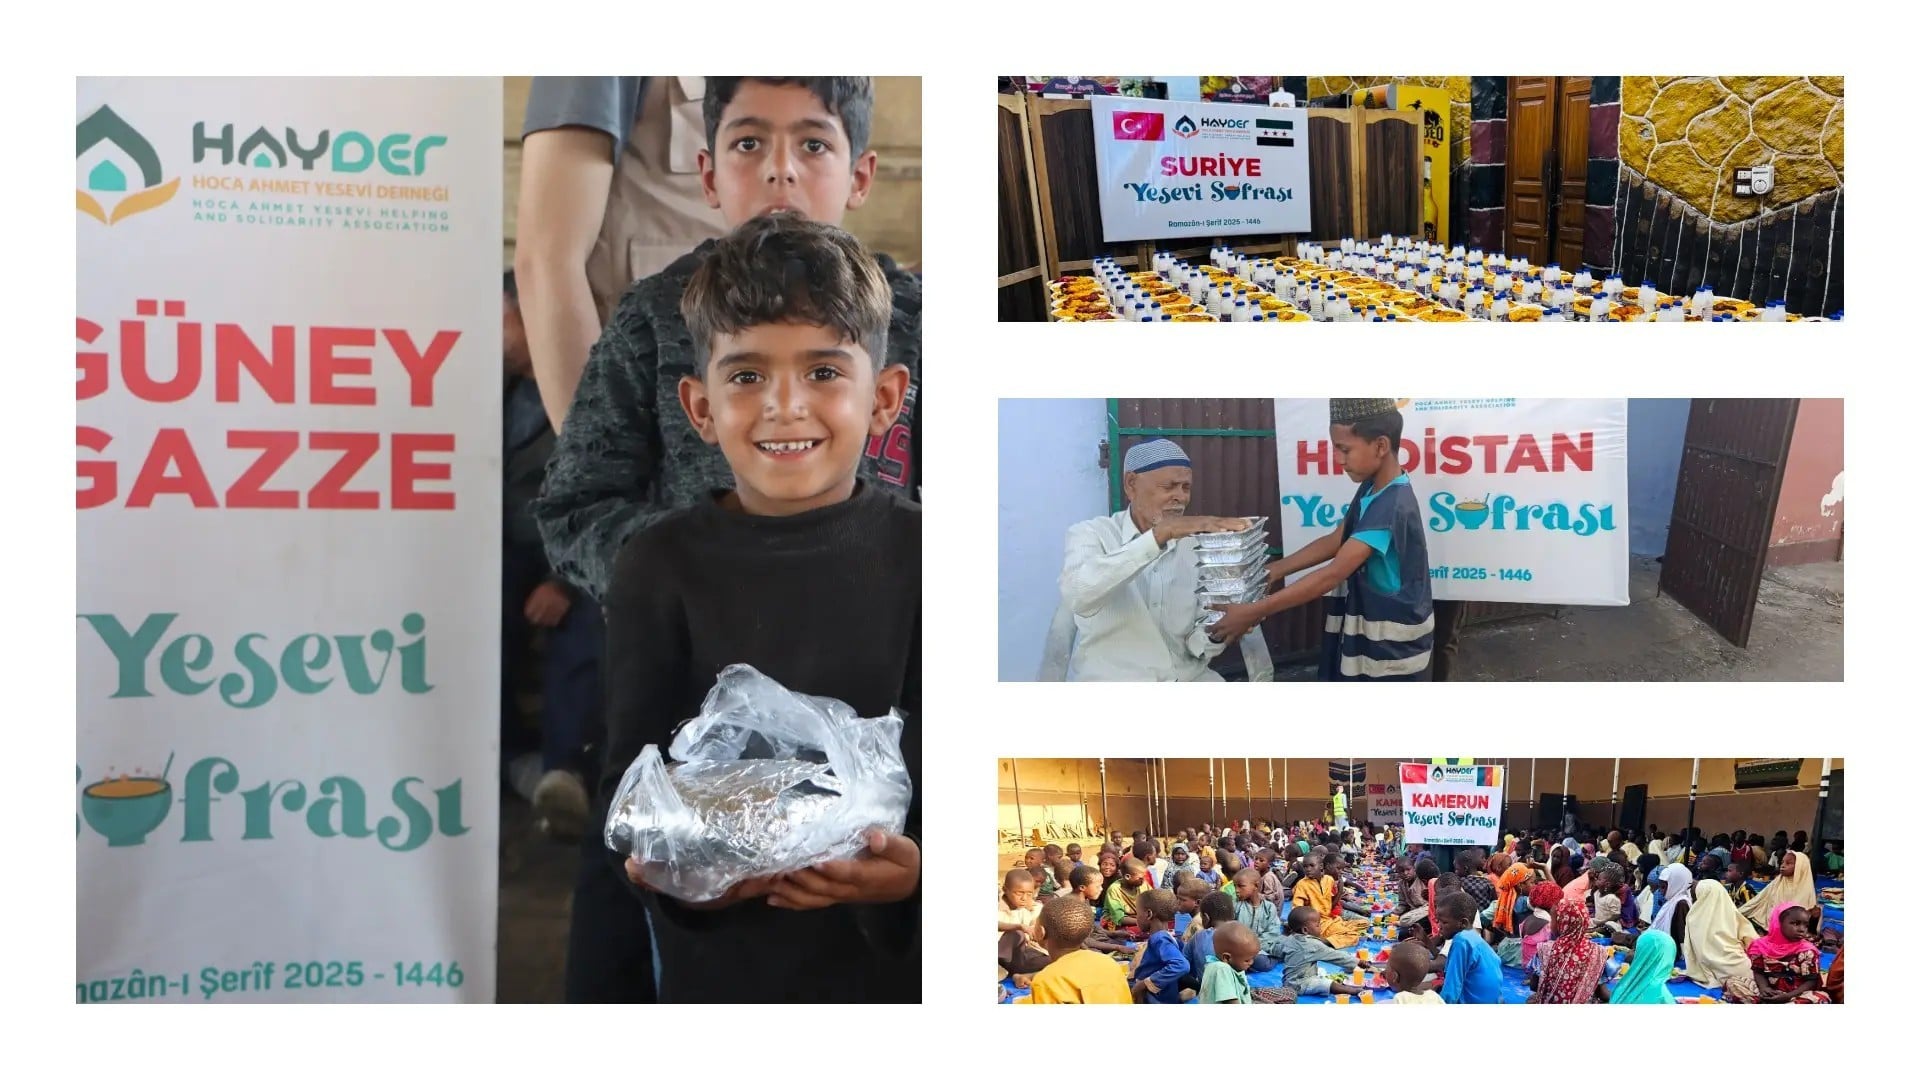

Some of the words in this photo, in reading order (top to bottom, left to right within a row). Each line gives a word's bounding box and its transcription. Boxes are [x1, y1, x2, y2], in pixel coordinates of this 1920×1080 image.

[1160, 153, 1262, 177] SURİYE
[192, 175, 244, 192] HOCA
[248, 178, 310, 195] AHMET
[376, 184, 450, 202] DERNEĞİ
[1123, 182, 1203, 204] Yesevi
[192, 199, 239, 210] HOCA
[249, 201, 304, 213] AHMET
[380, 208, 449, 220] HELPING
[194, 211, 227, 222] AND
[236, 214, 333, 227] SOLIDARITY
[343, 220, 449, 233] ASSOCIATION
[1223, 218, 1241, 226] 2025
[1246, 218, 1261, 226] 1446
[1297, 427, 1594, 476] HDİSTAN
[1429, 566, 1449, 580] erîf
[1452, 567, 1487, 581] 2025
[1500, 568, 1533, 582] 1446
[76, 612, 436, 709] Yesevi
[76, 751, 472, 852] ofrası
[1412, 793, 1489, 809] KAMERUN
[1404, 811, 1443, 827] Yesevi
[284, 961, 365, 989] 2025
[393, 961, 464, 988] 1446
